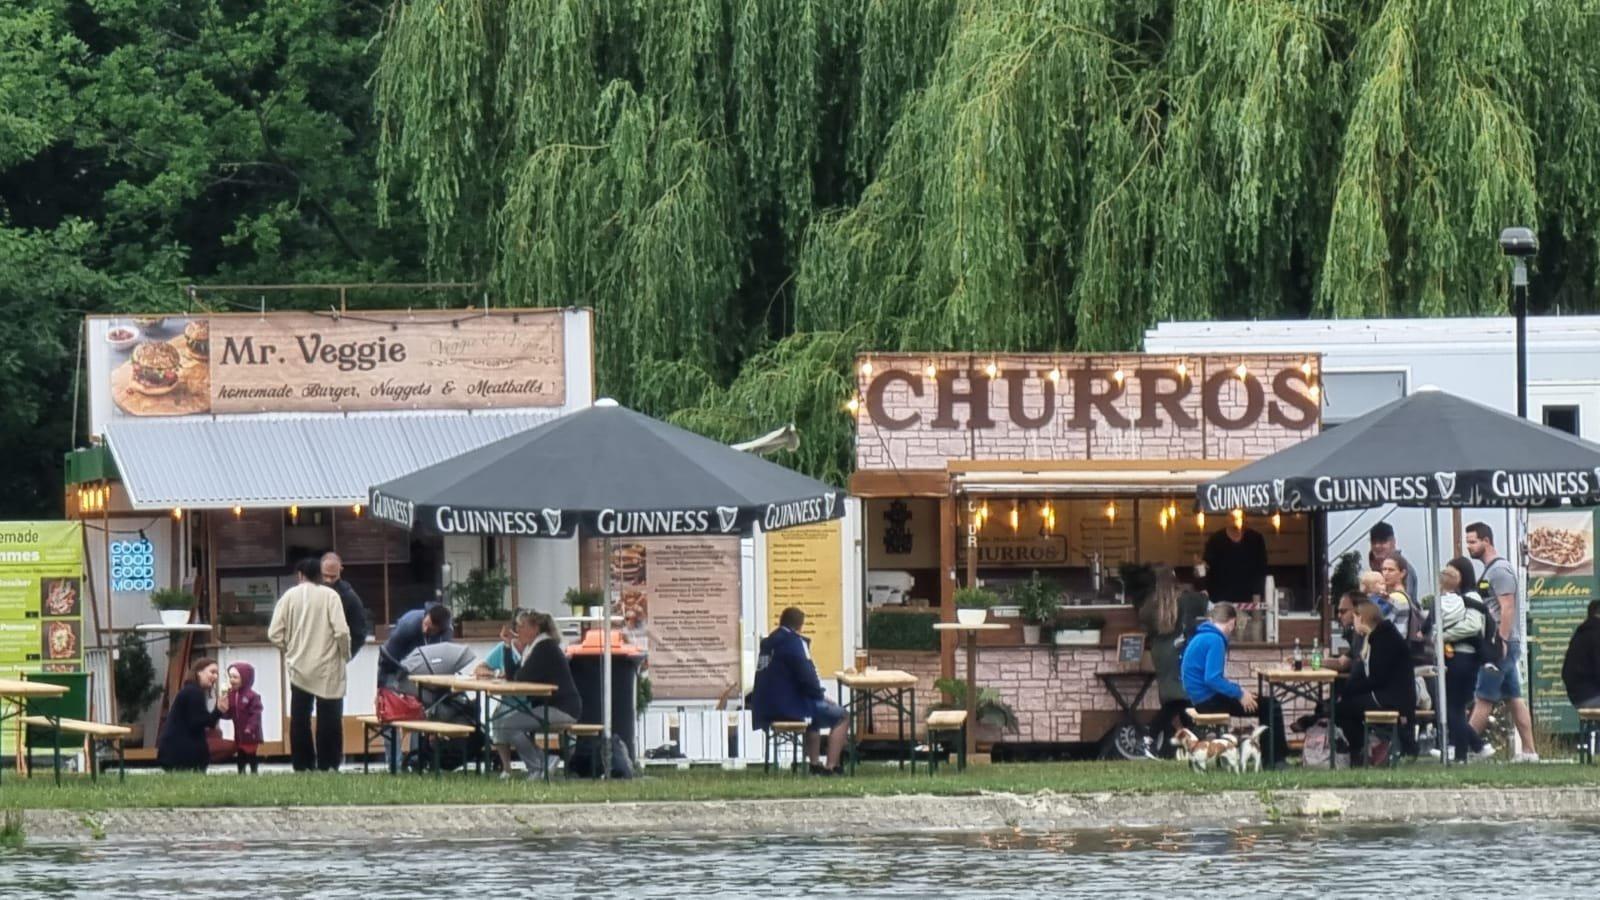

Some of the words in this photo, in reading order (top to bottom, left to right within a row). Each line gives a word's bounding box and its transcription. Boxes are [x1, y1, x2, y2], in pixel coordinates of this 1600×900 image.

[218, 336, 286, 365] Mr.
[295, 332, 407, 371] Veggie
[218, 384, 294, 400] homemade
[301, 382, 361, 403] Burger,
[370, 377, 432, 402] Nuggets
[441, 380, 457, 395] &
[467, 378, 544, 398] Meatballs
[865, 368, 1320, 431] CHURROS
[1207, 483, 1270, 512] GUINNESS
[1313, 475, 1429, 503] GUINNESS
[1492, 470, 1590, 498] GUINNESS
[372, 489, 409, 526] GUINNESS
[436, 505, 538, 535] GUINNESS
[763, 496, 822, 531] GUINNESS
[597, 508, 709, 535] GUINNESS
[111, 542, 153, 554] GOOD
[111, 554, 154, 566] FOOD
[977, 546, 1058, 560] URROS
[111, 566, 154, 578] GOOD
[111, 578, 155, 591] MOOD
[1527, 577, 1592, 597] Insekten
